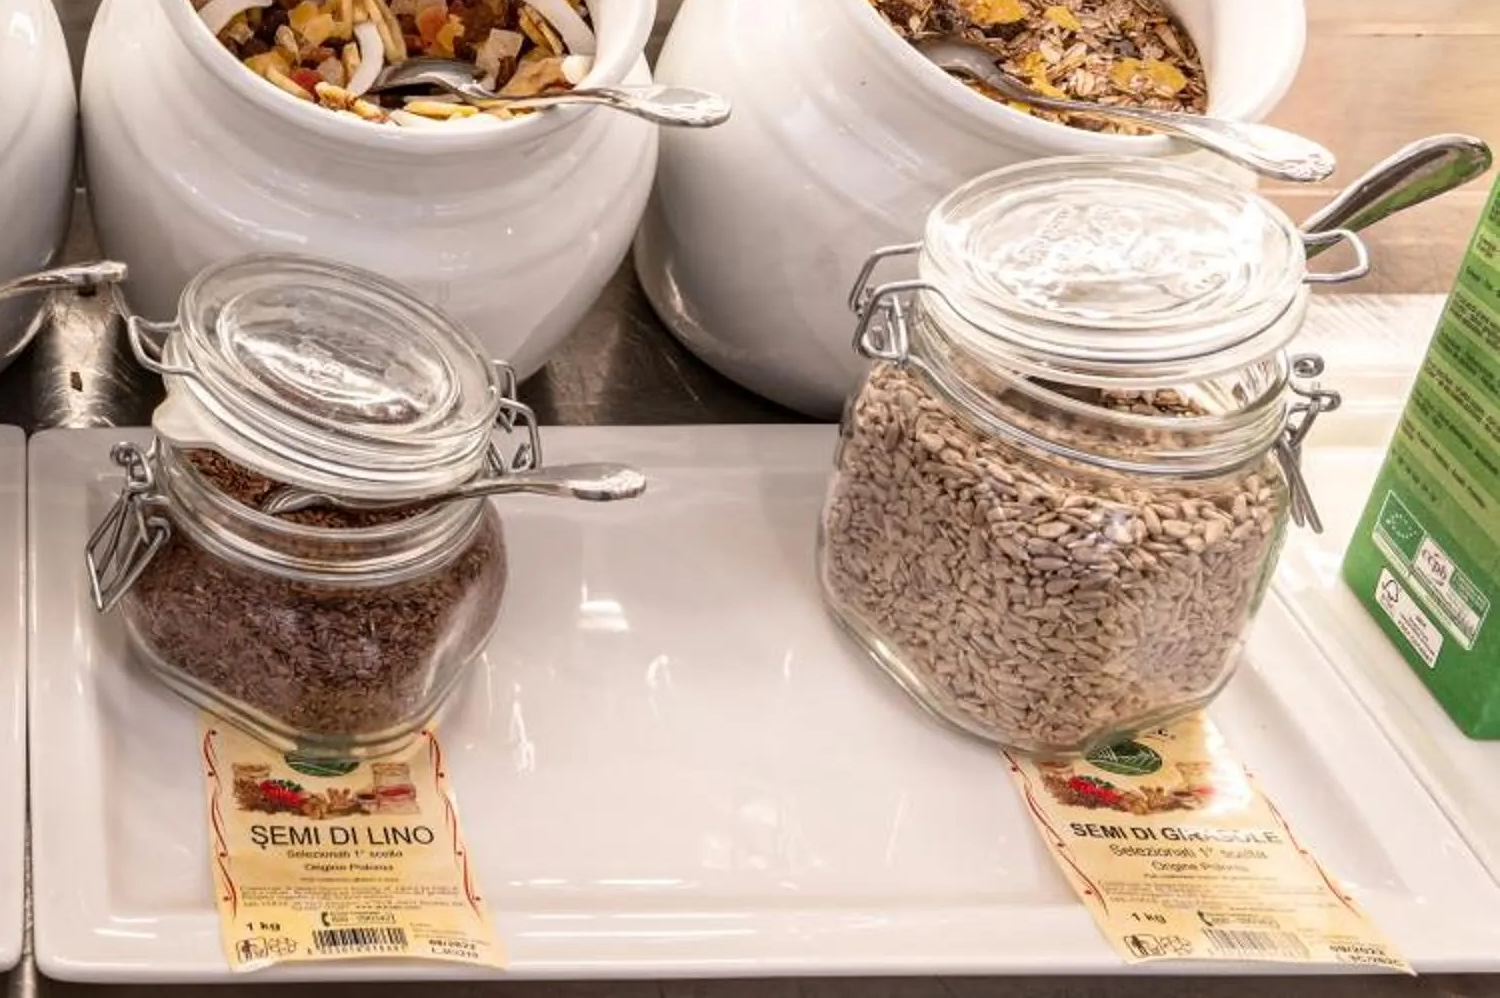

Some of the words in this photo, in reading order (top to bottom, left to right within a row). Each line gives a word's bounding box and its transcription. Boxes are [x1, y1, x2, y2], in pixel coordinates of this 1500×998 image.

[251, 825, 321, 847] SEMI
[330, 826, 358, 845] DI
[367, 826, 434, 846] LINO
[1069, 822, 1128, 840] SEMI
[1130, 826, 1158, 841] DI
